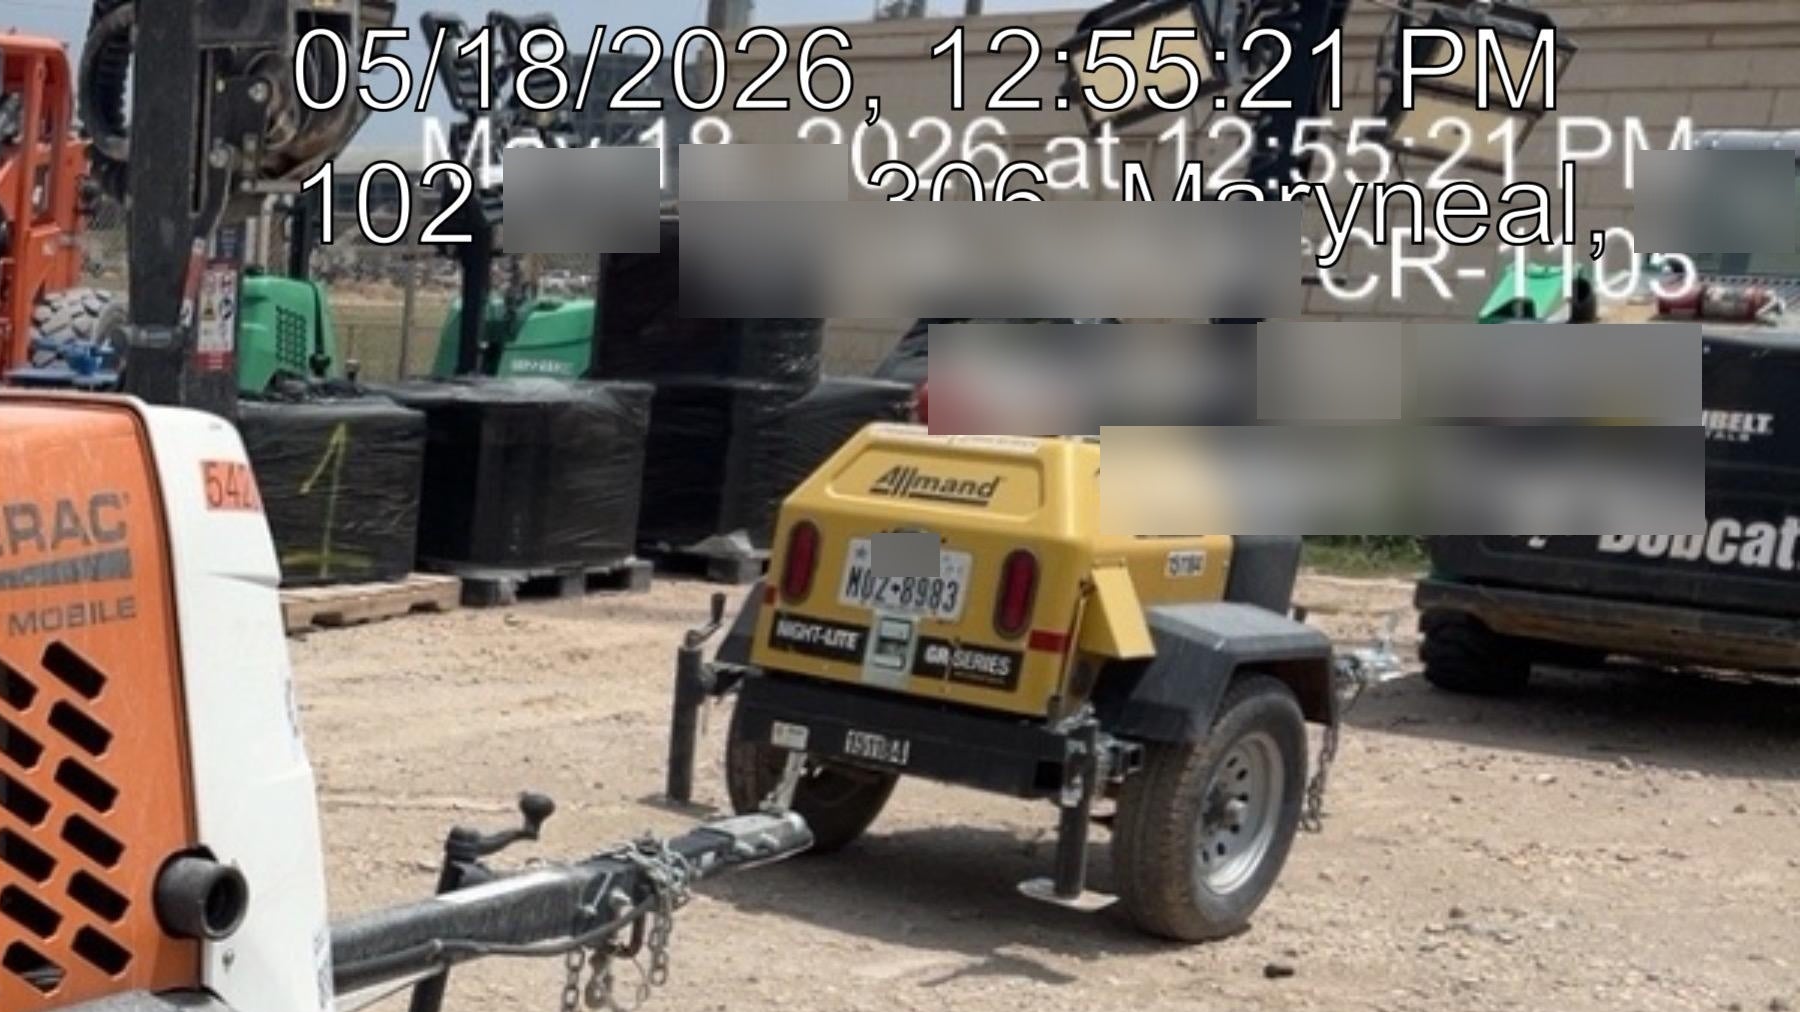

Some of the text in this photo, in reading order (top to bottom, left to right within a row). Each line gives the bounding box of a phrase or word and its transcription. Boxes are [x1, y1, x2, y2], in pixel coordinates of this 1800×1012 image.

[873, 463, 1002, 500] Allmand
[7, 596, 138, 637] MOBILE
[776, 619, 864, 651] NIGHT-LITE
